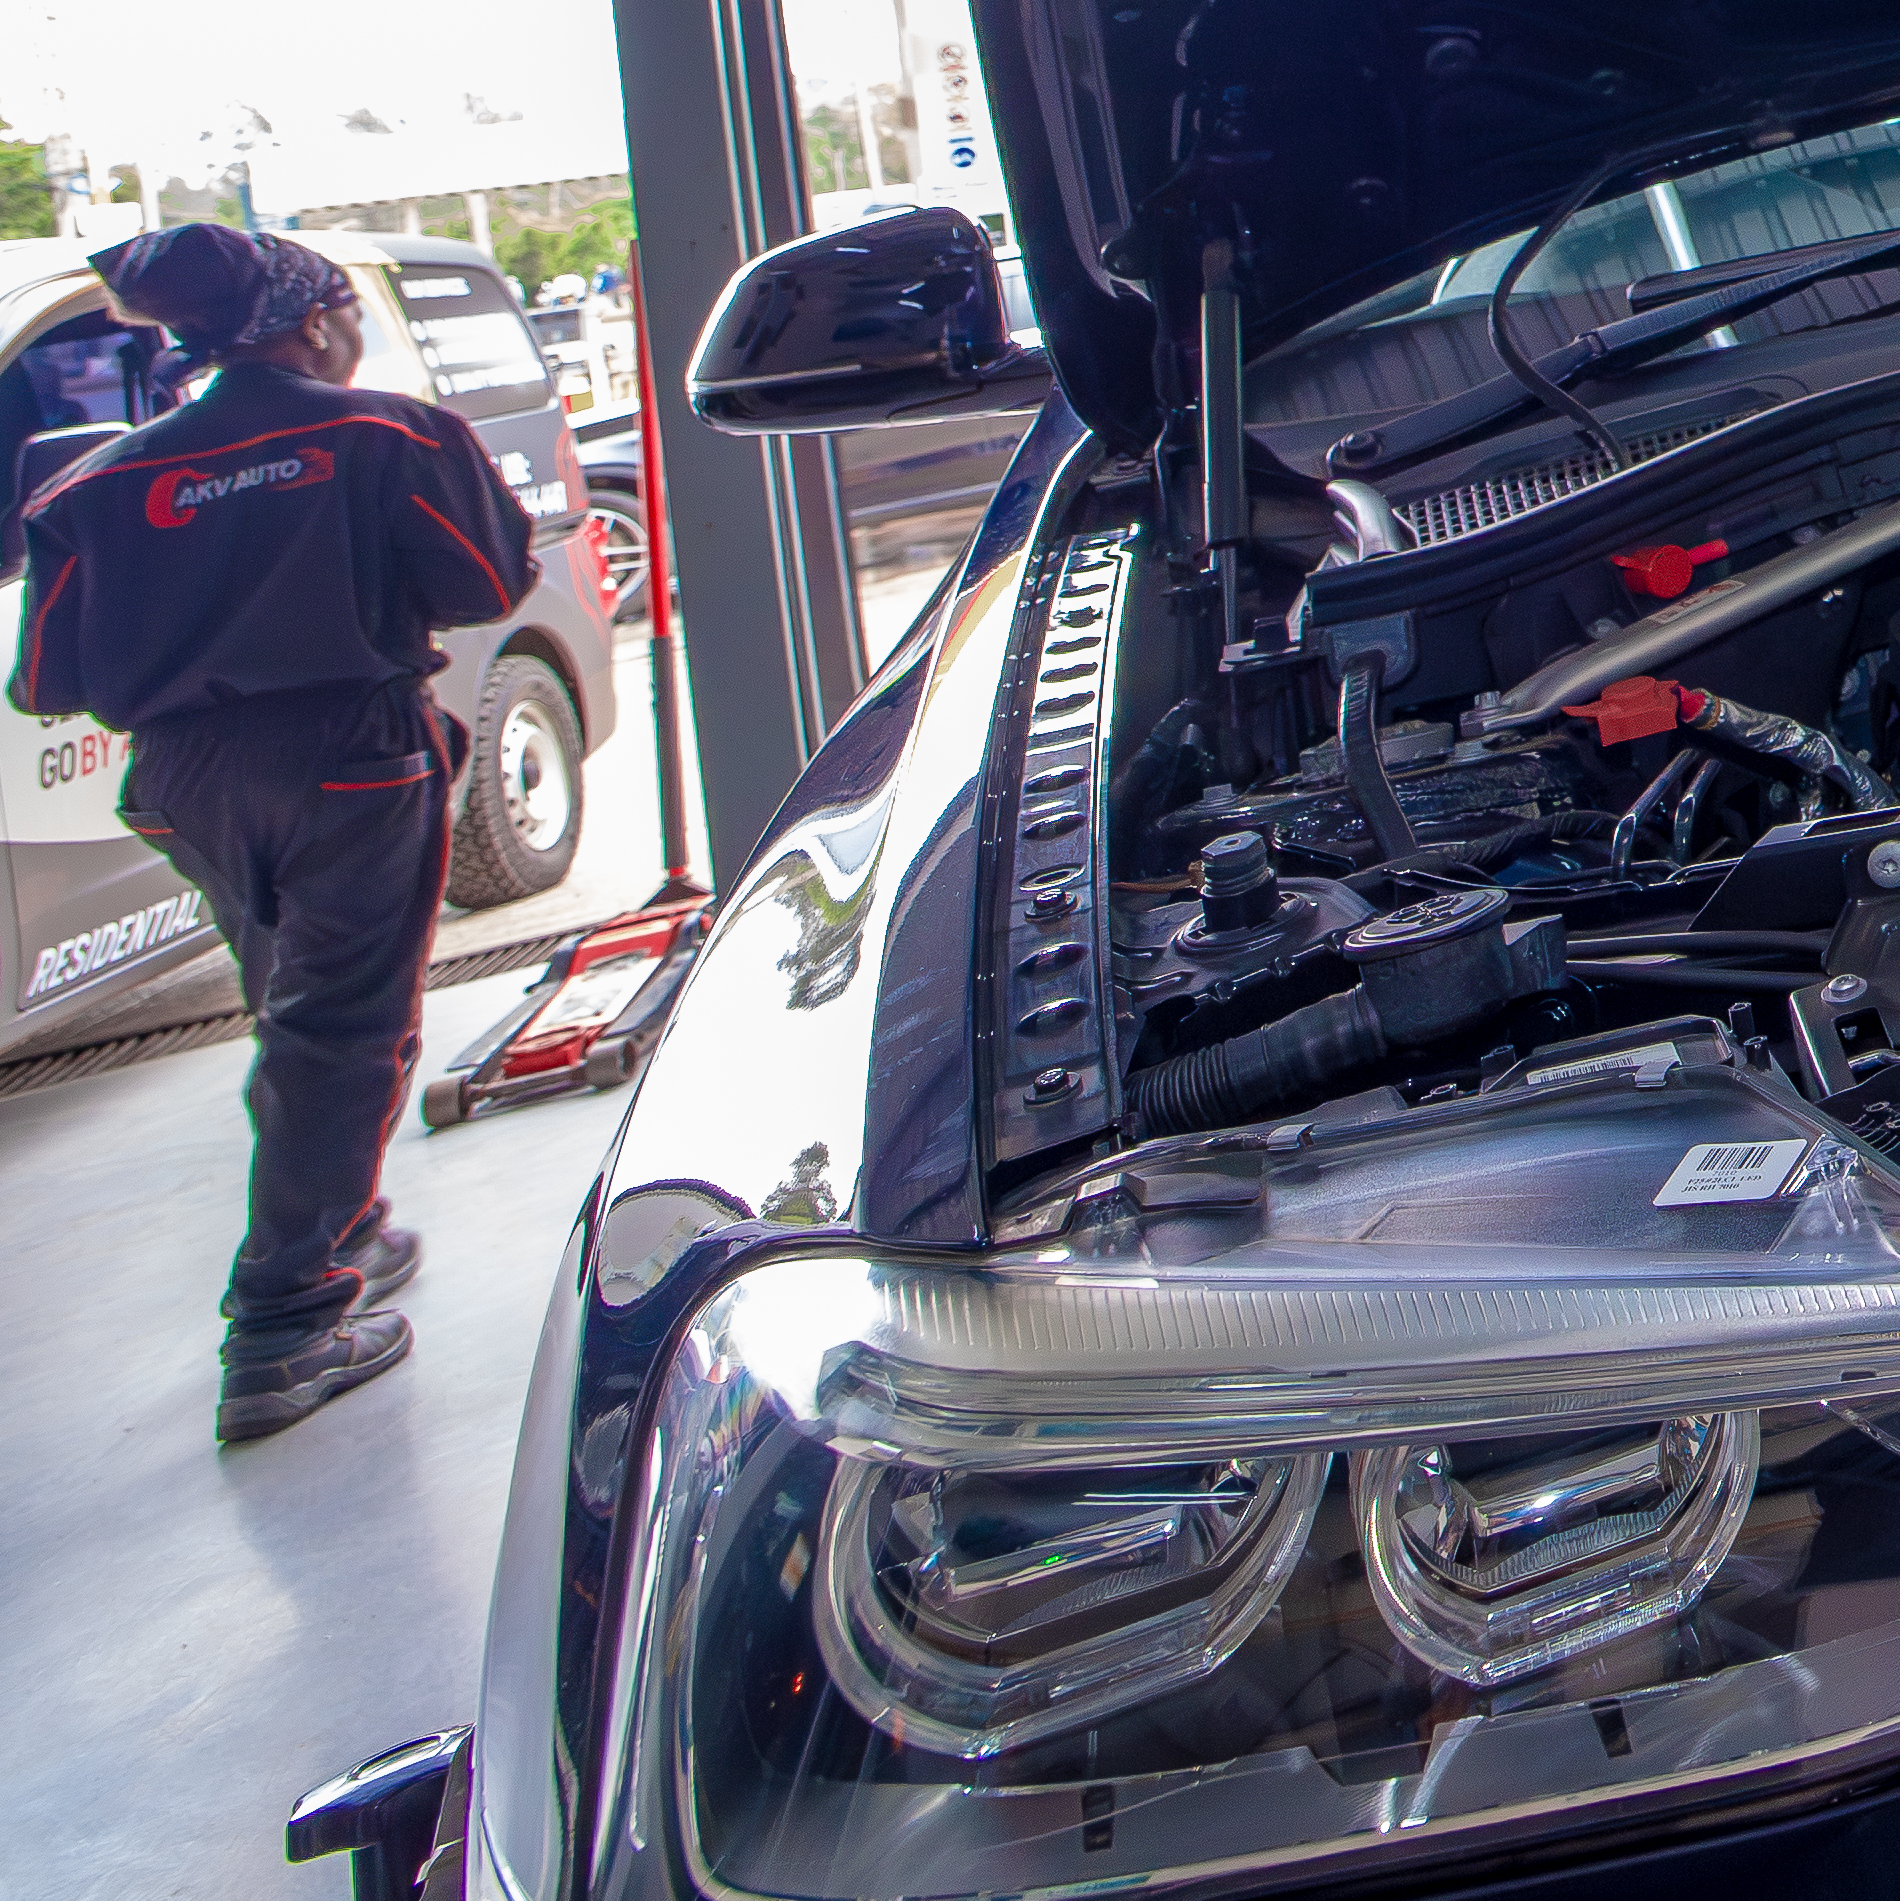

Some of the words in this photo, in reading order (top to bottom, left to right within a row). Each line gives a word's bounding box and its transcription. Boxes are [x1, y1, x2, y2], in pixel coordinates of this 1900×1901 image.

[174, 475, 234, 508] AKV
[231, 458, 303, 492] AUTO
[25, 889, 204, 999] RESIDENTIAL
